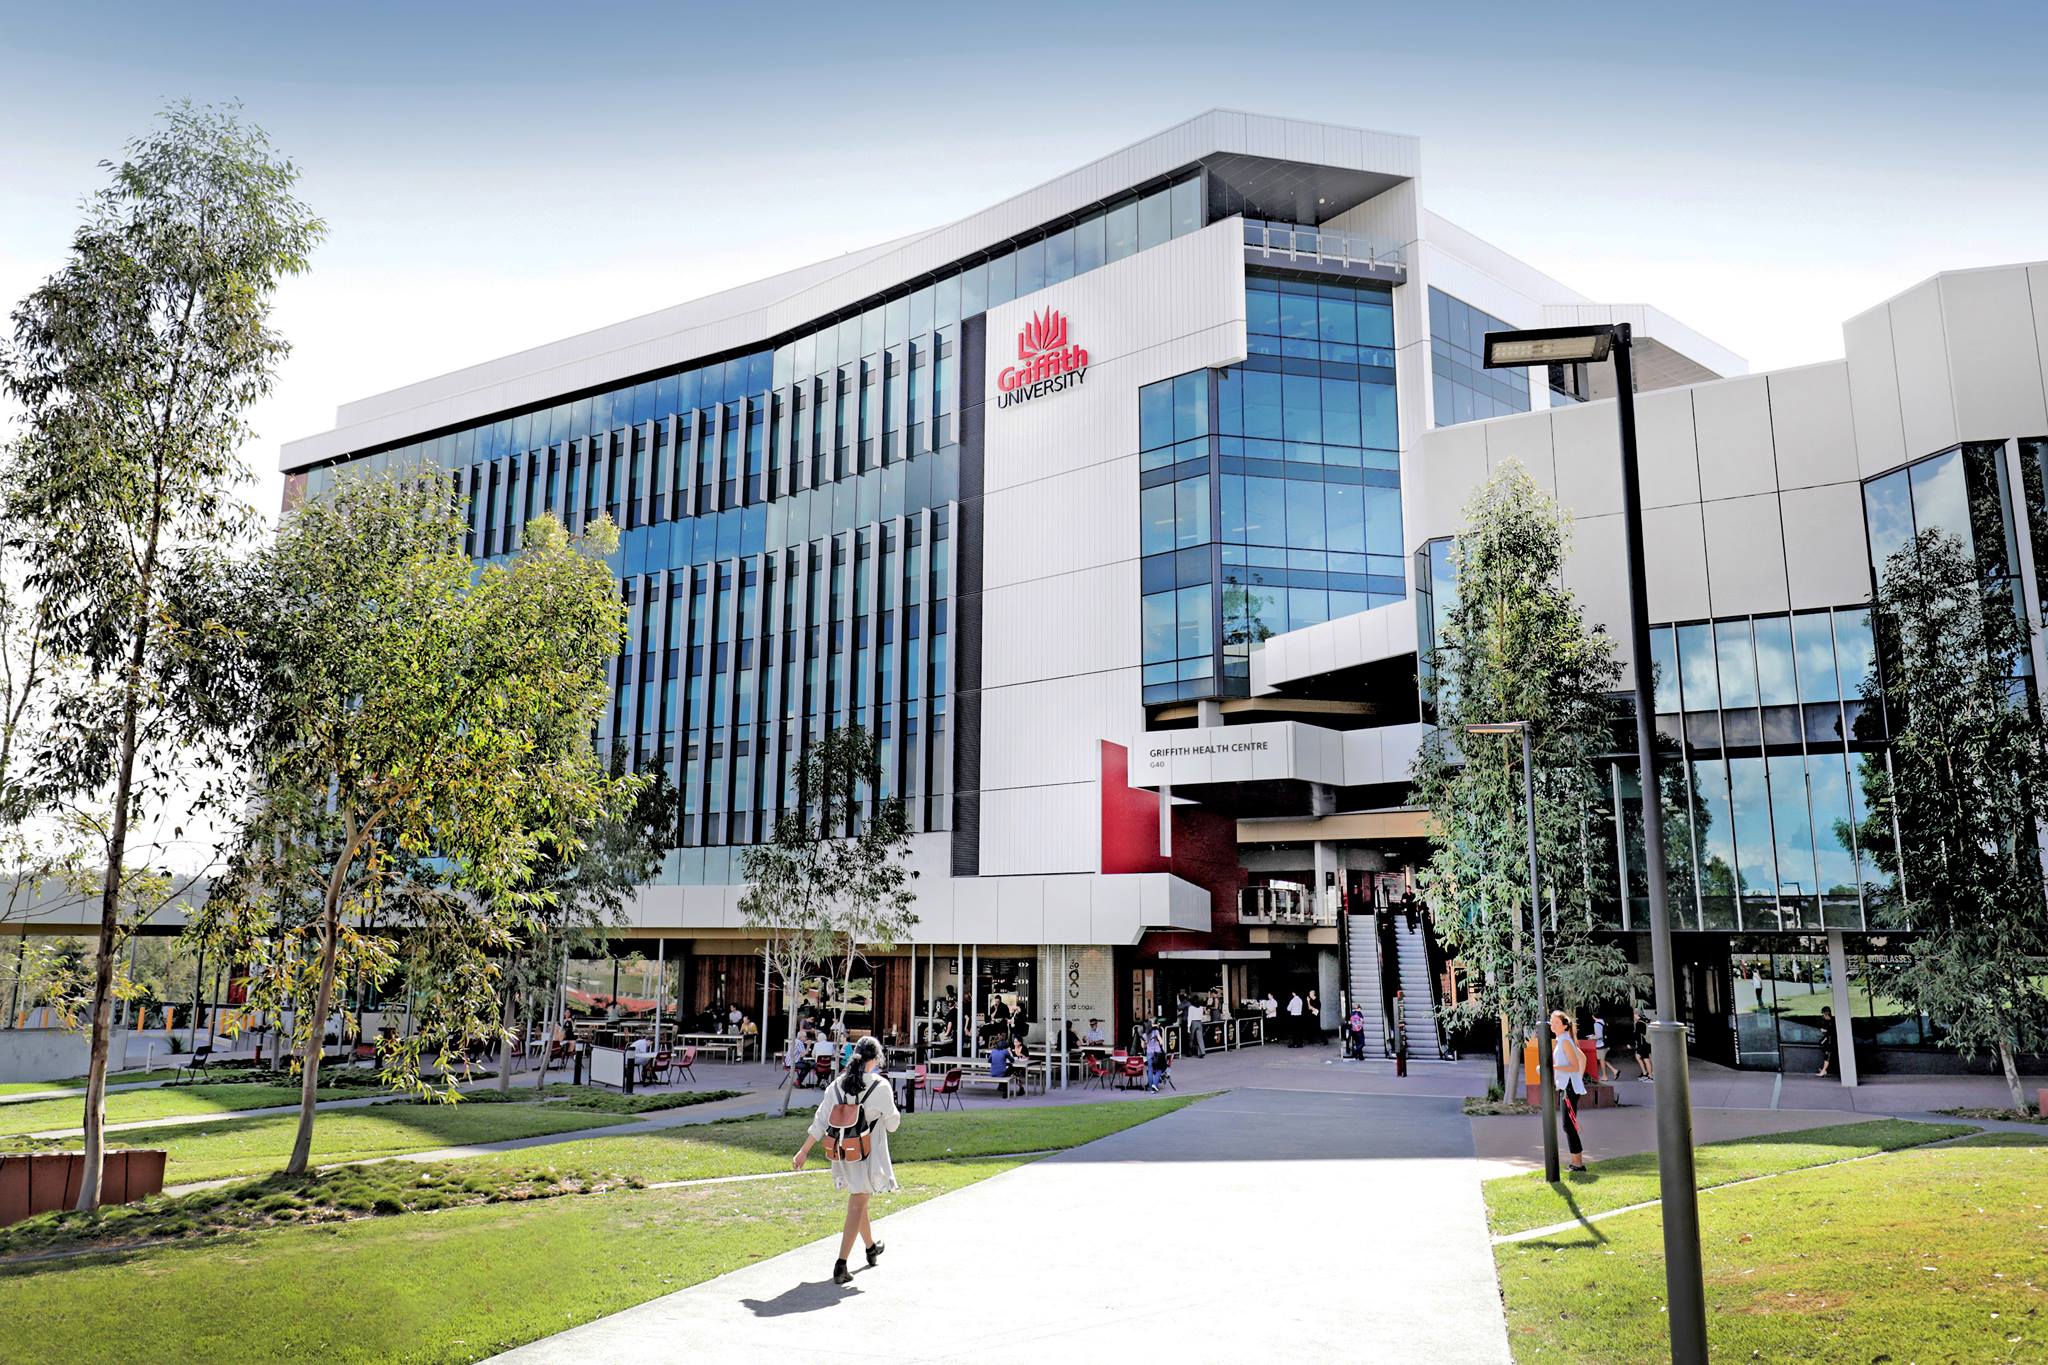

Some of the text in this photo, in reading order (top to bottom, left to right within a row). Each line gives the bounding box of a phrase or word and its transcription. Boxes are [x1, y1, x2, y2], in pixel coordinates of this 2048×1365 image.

[997, 344, 1088, 392] Griffith
[997, 368, 1087, 409] UNIVERSITY
[1149, 741, 1268, 758] GRIFFITH HEALTH CENTRE
